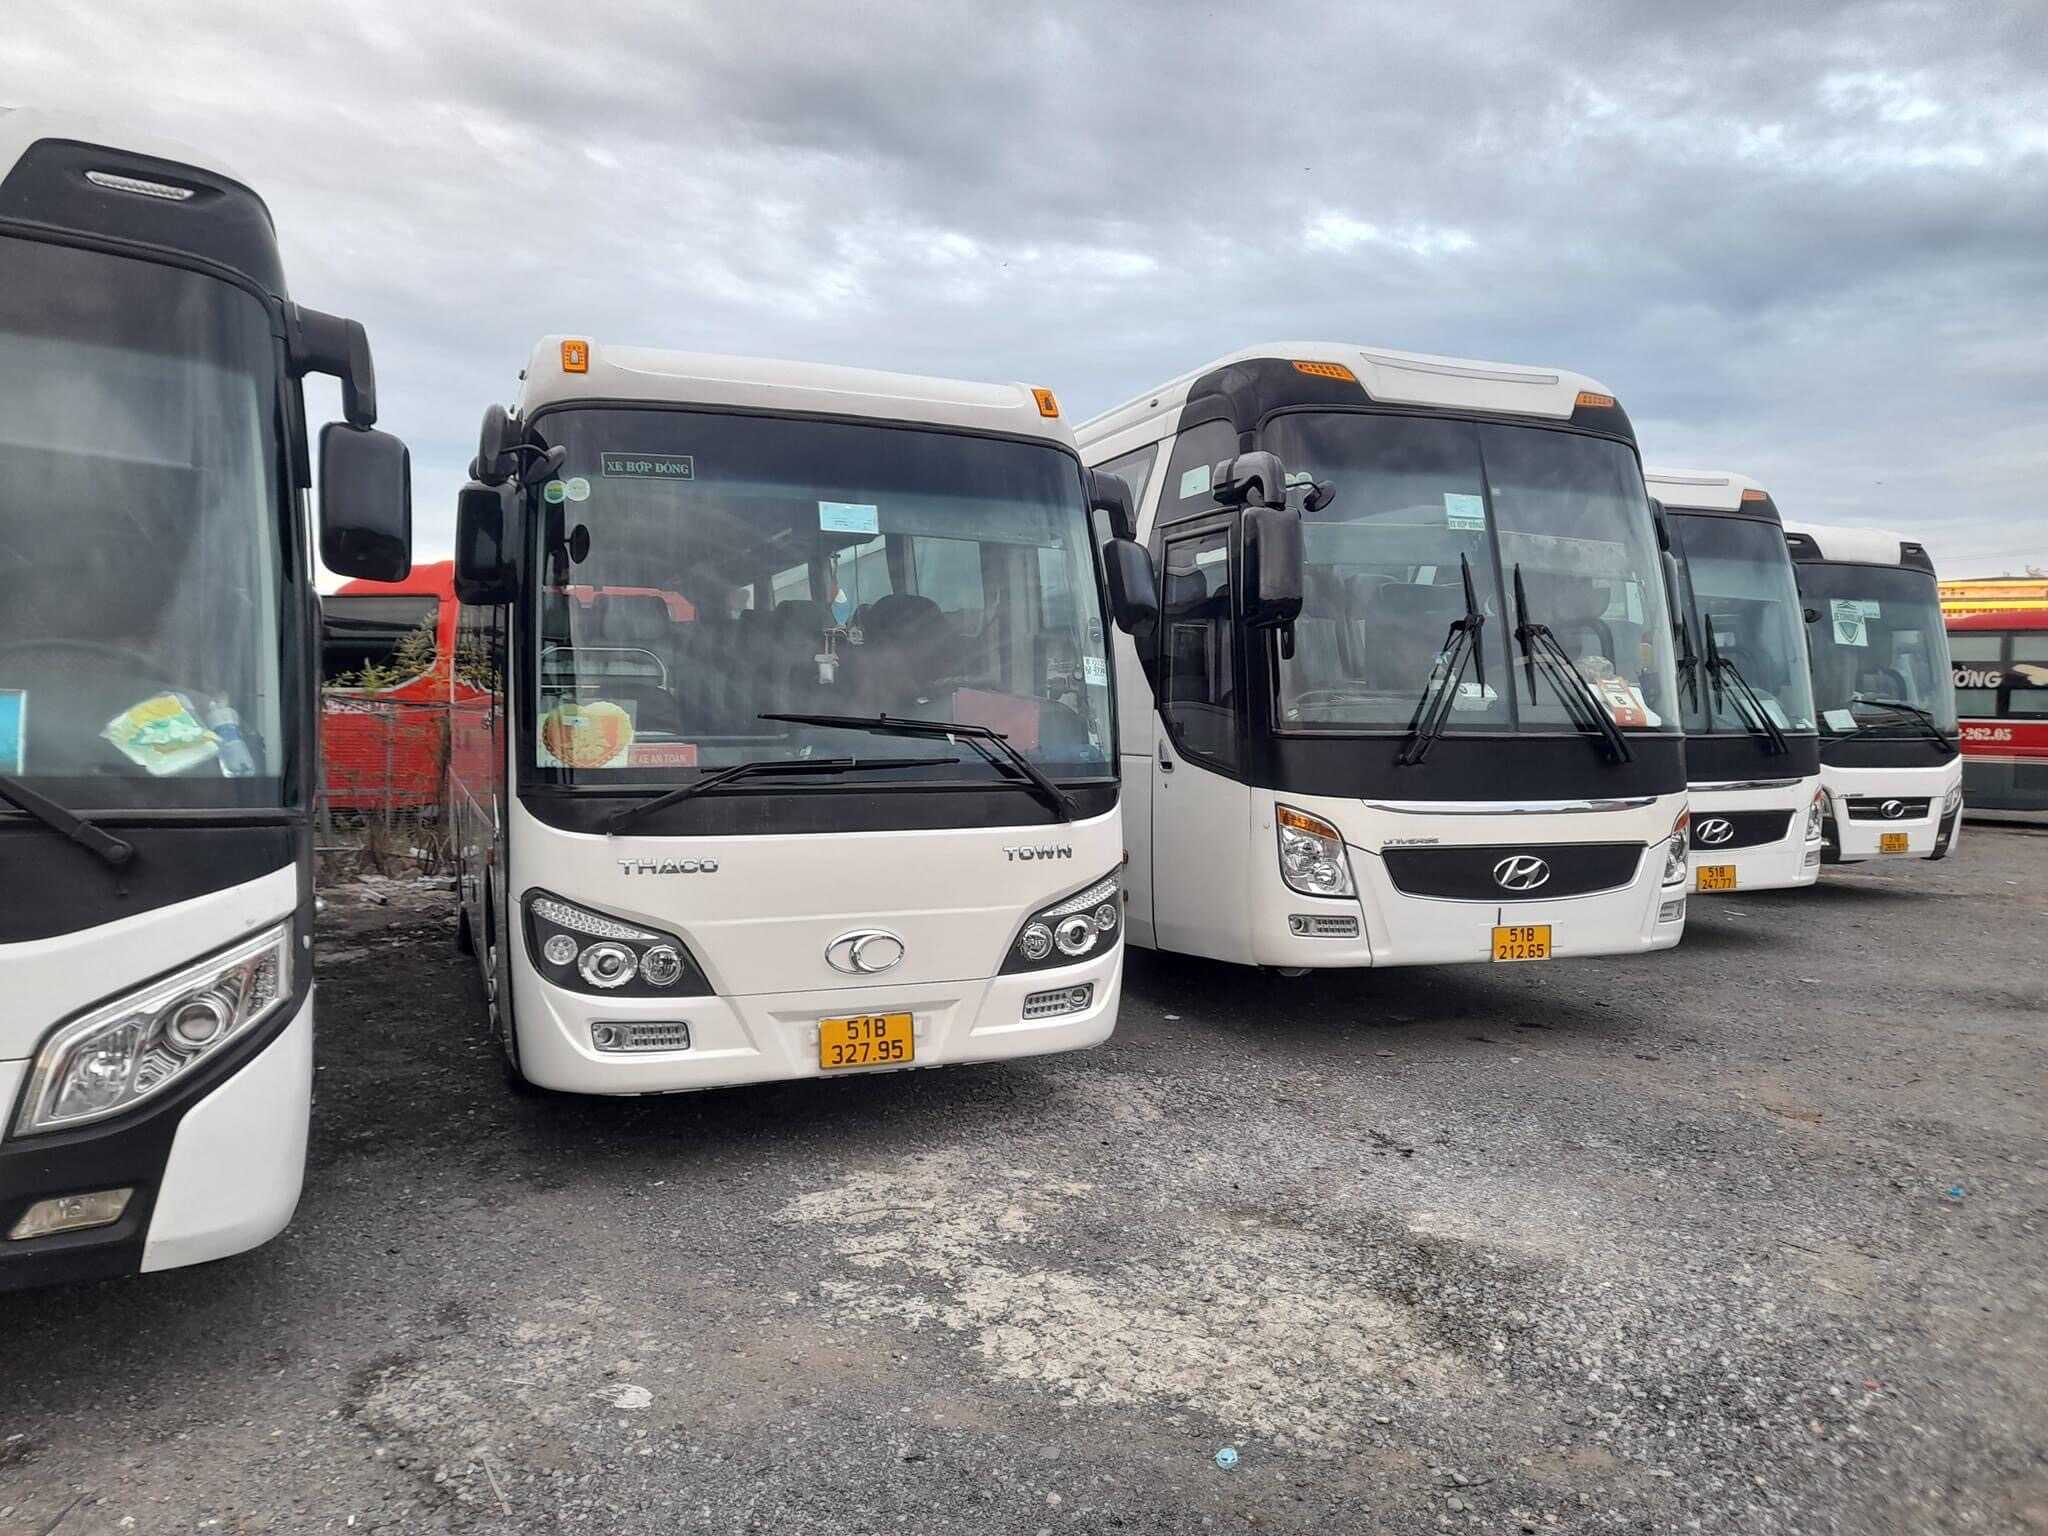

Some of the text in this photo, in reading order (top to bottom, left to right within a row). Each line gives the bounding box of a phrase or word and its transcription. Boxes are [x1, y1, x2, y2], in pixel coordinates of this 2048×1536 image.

[1002, 845, 1072, 861] TOWN
[617, 857, 719, 875] THACO
[1509, 927, 1535, 943] 51B
[1498, 943, 1545, 960] 212.65
[847, 1018, 886, 1040] 51B
[831, 1039, 904, 1064] 327.95
